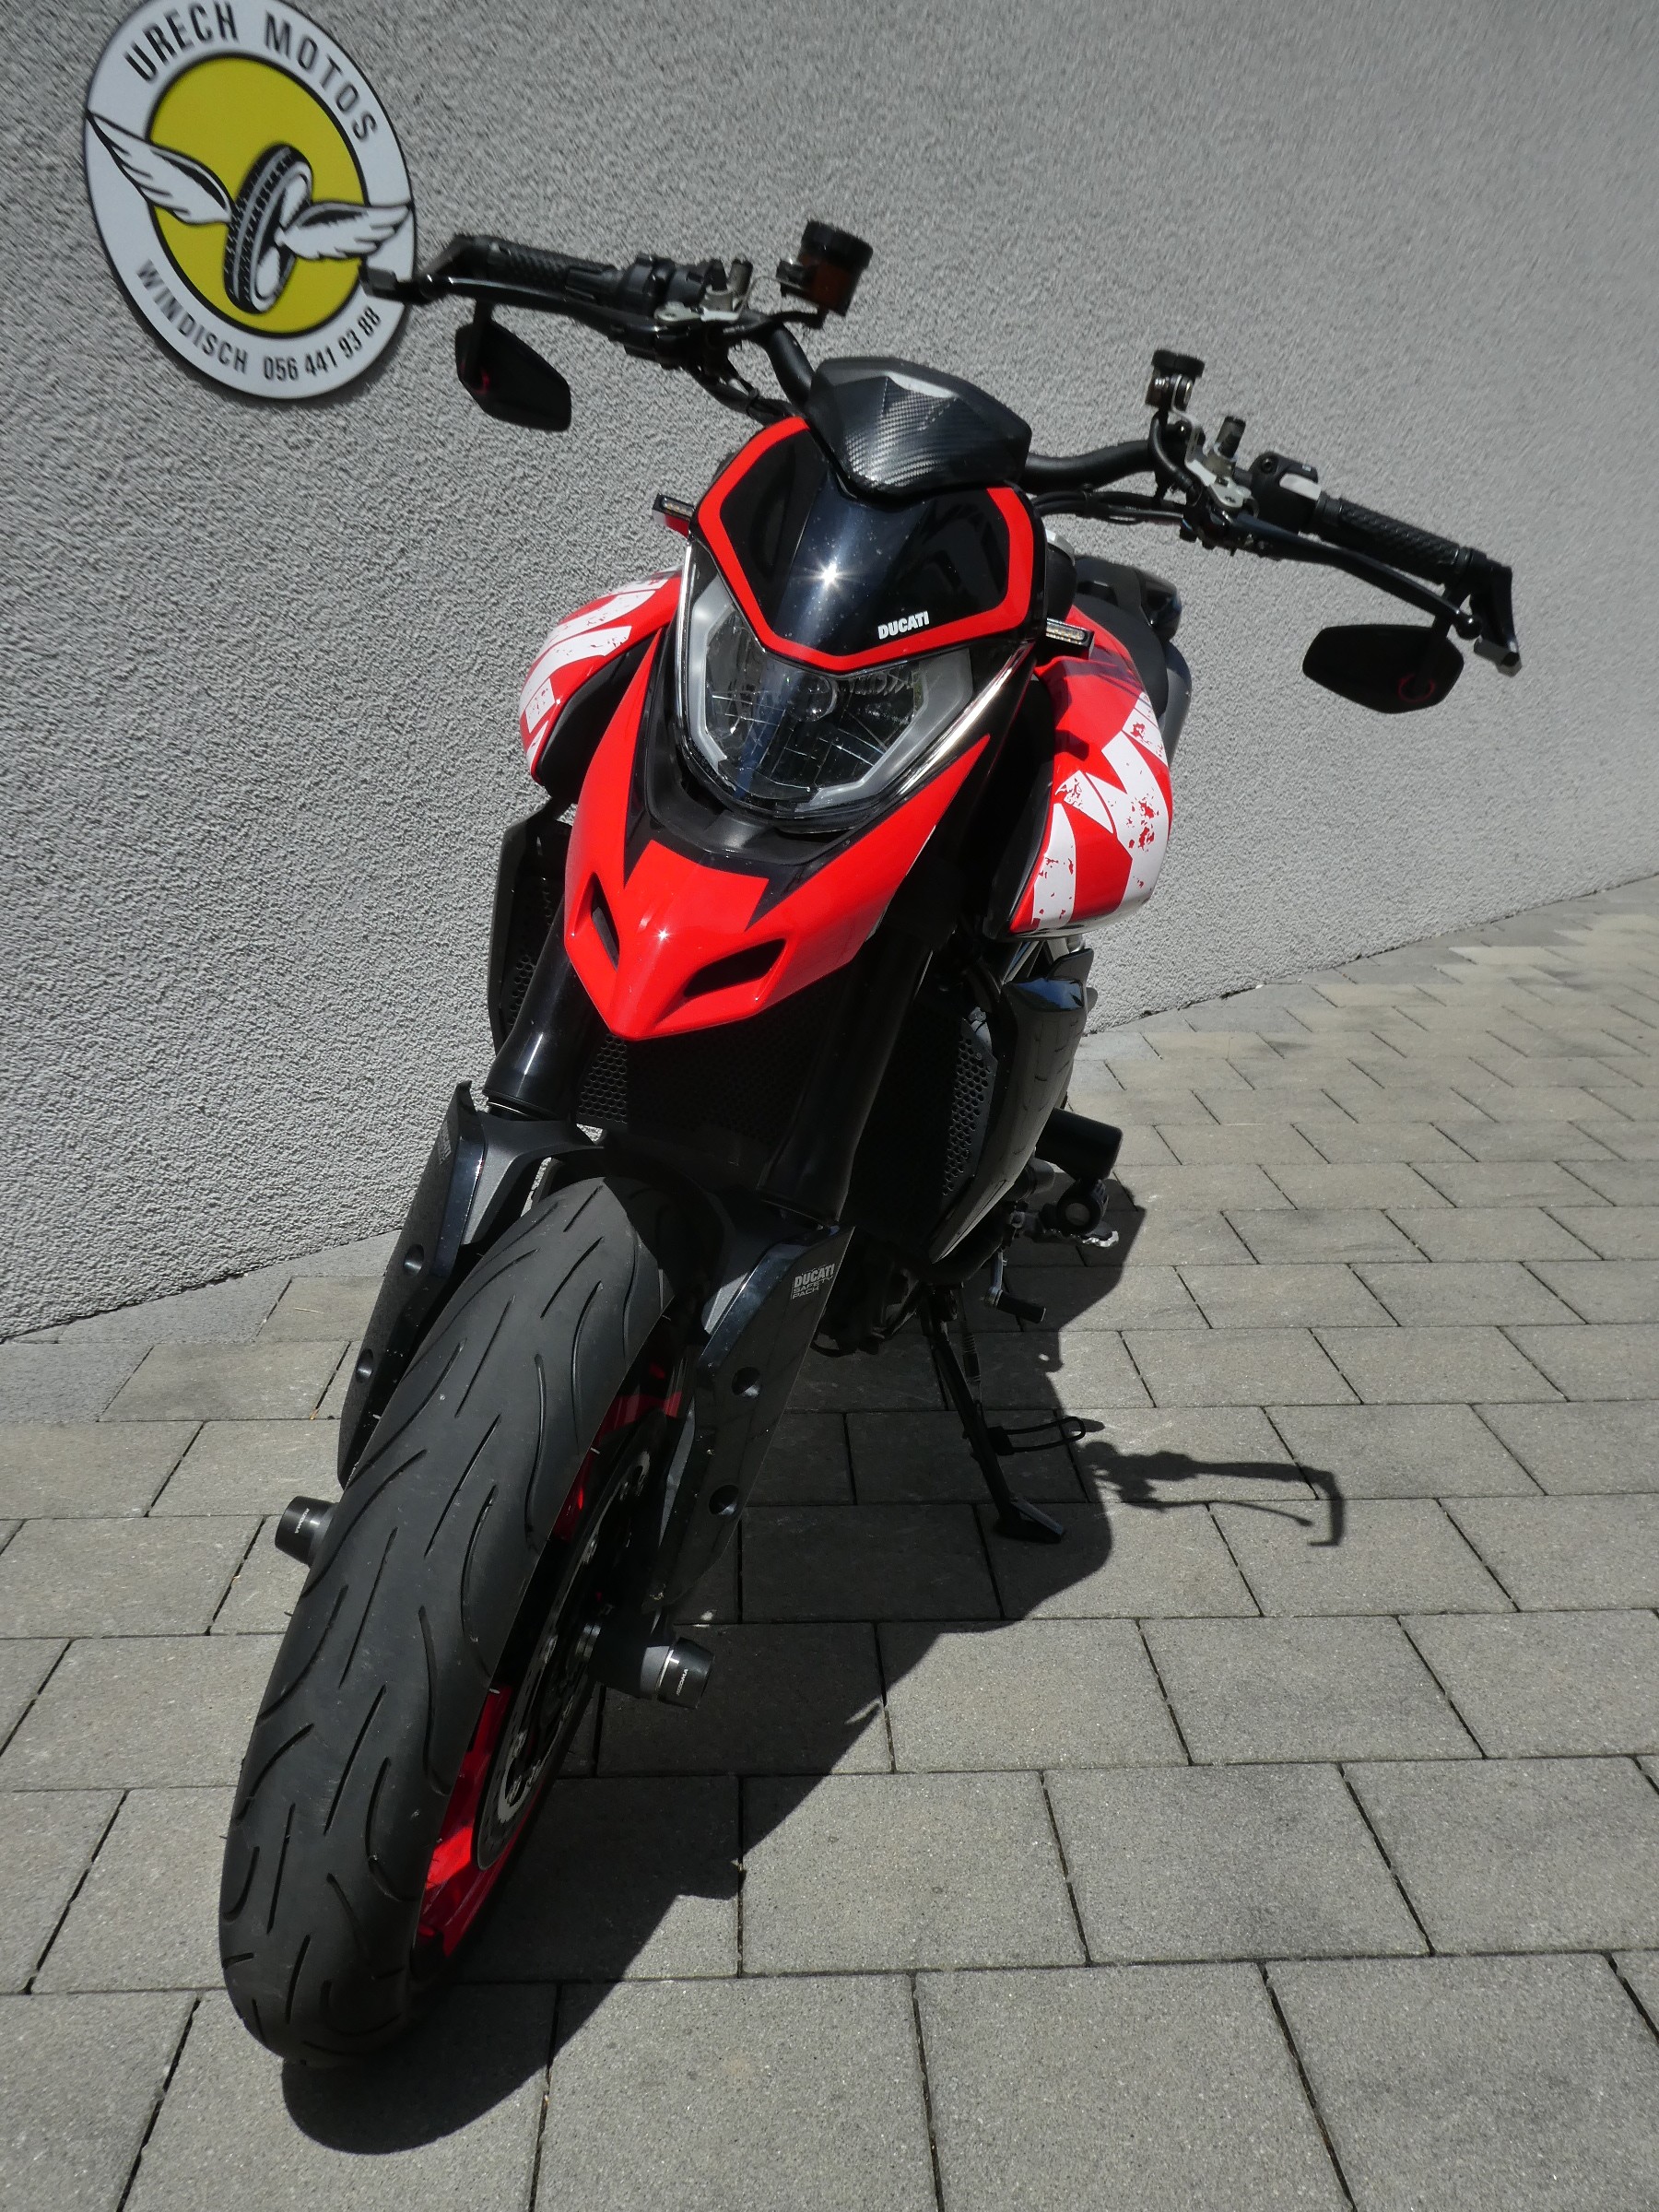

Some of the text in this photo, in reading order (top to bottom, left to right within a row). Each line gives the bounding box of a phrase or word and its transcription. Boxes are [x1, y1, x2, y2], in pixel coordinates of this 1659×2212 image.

[124, 1, 378, 142] URECH MOTOS
[136, 258, 248, 374] WINDISCH
[264, 355, 298, 381] 056
[305, 344, 337, 376] 441
[337, 327, 362, 359] 93
[877, 610, 930, 640] DUCATI
[794, 1264, 835, 1288] DUCATI
